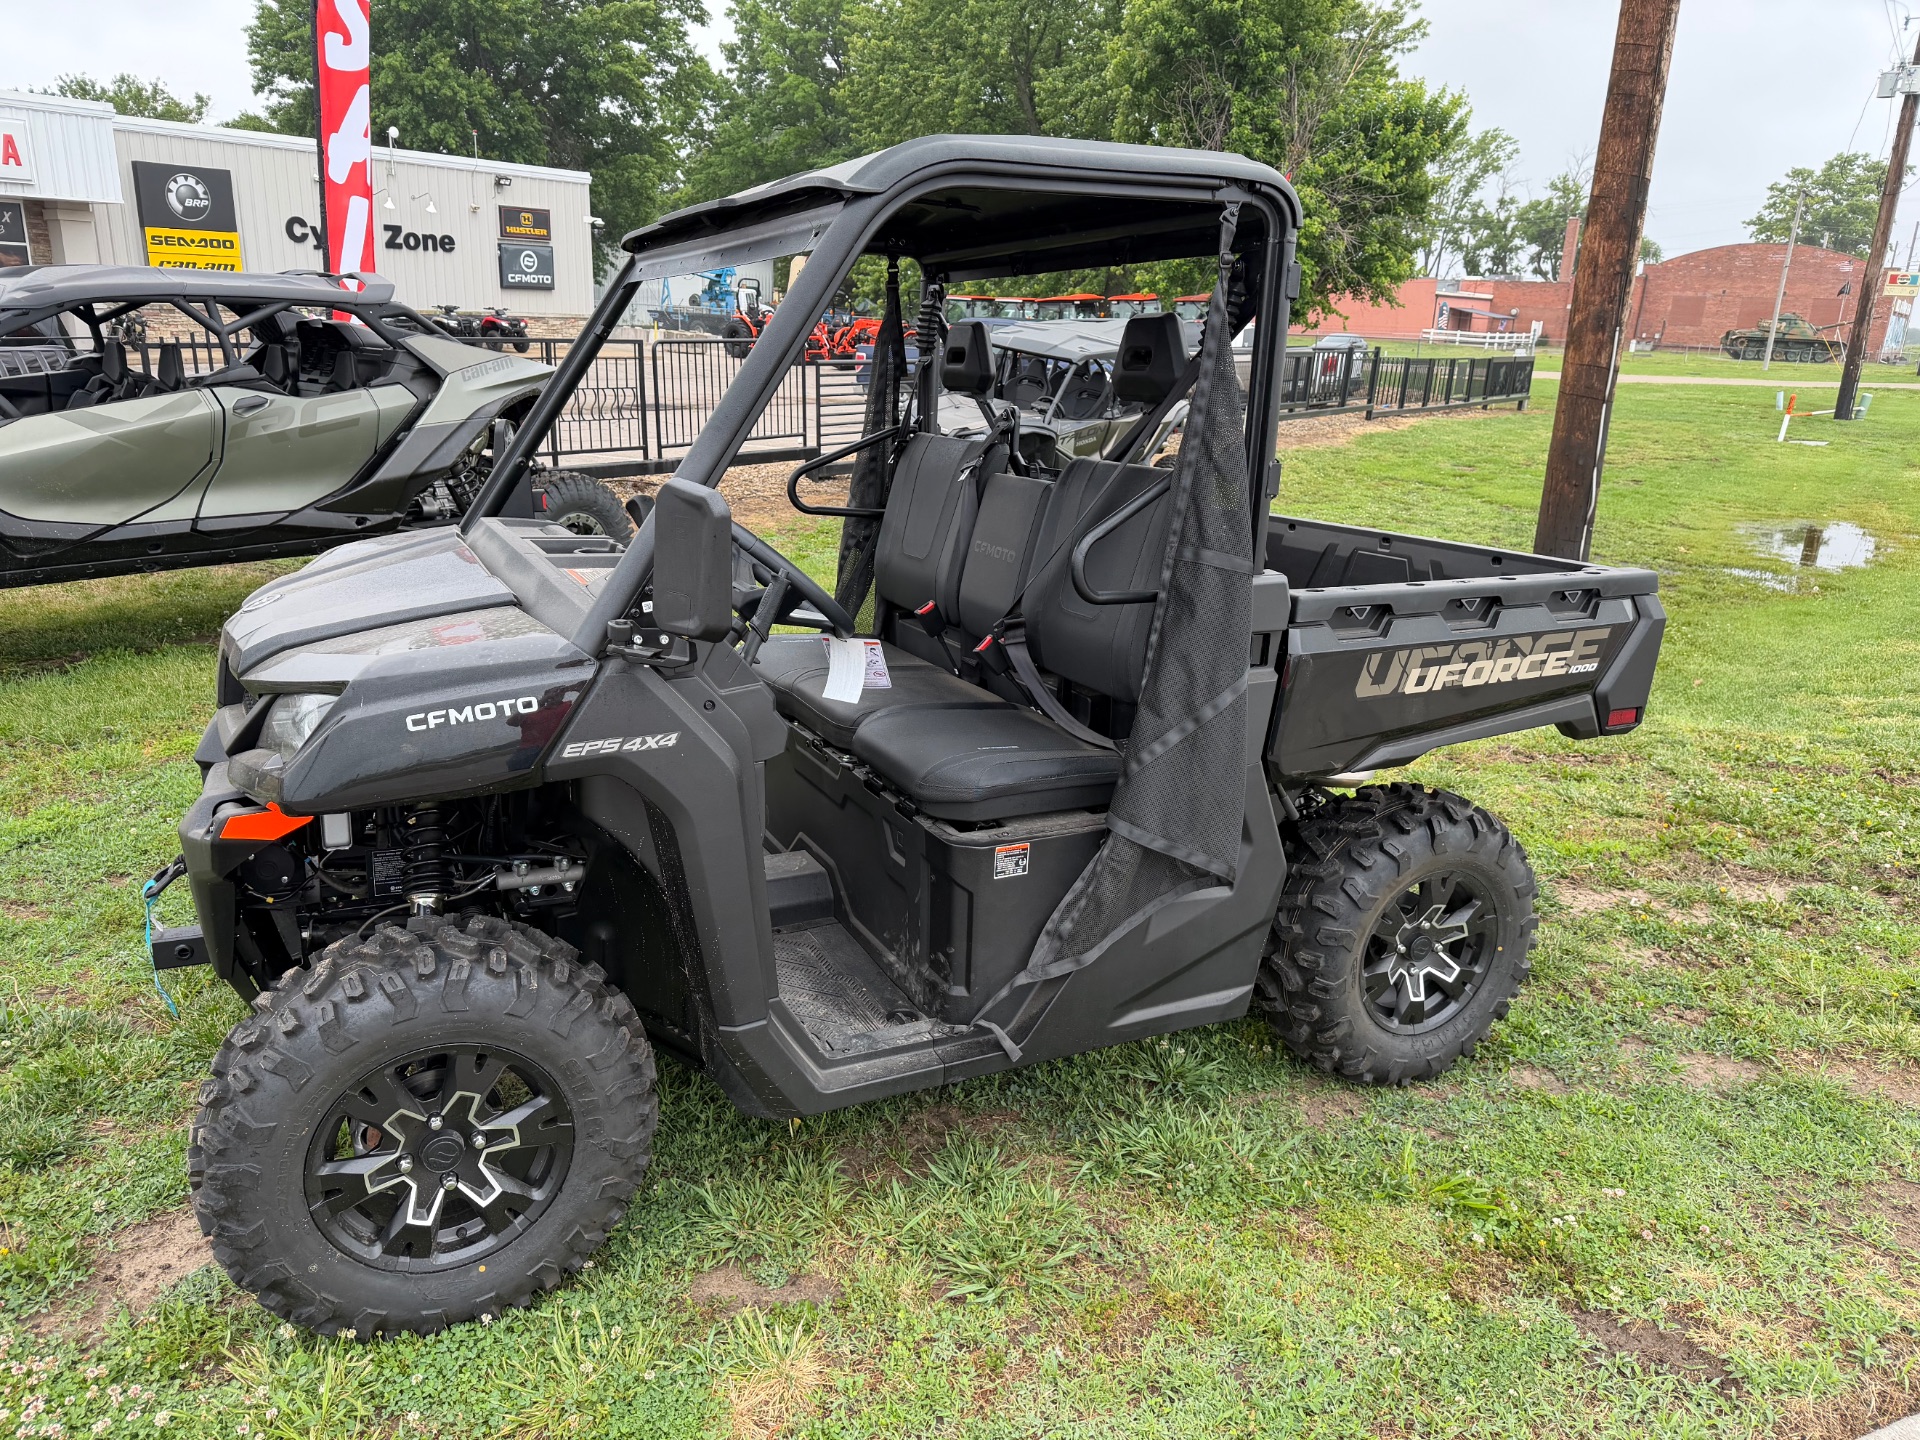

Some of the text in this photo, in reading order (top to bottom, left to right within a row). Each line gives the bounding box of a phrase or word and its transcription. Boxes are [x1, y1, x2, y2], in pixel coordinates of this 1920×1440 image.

[184, 198, 209, 208] BRP
[383, 224, 456, 252] Zone
[506, 226, 548, 236] HUSTLER
[507, 273, 552, 284] CFMOTO
[461, 355, 514, 383] can-am
[1059, 424, 1107, 445] TALON
[1075, 436, 1097, 447] HONDA
[974, 540, 1016, 563] CFMOTO
[1404, 650, 1598, 695] UFORCE 1000
[405, 696, 539, 732] CFMOTO
[560, 736, 624, 758] EPS
